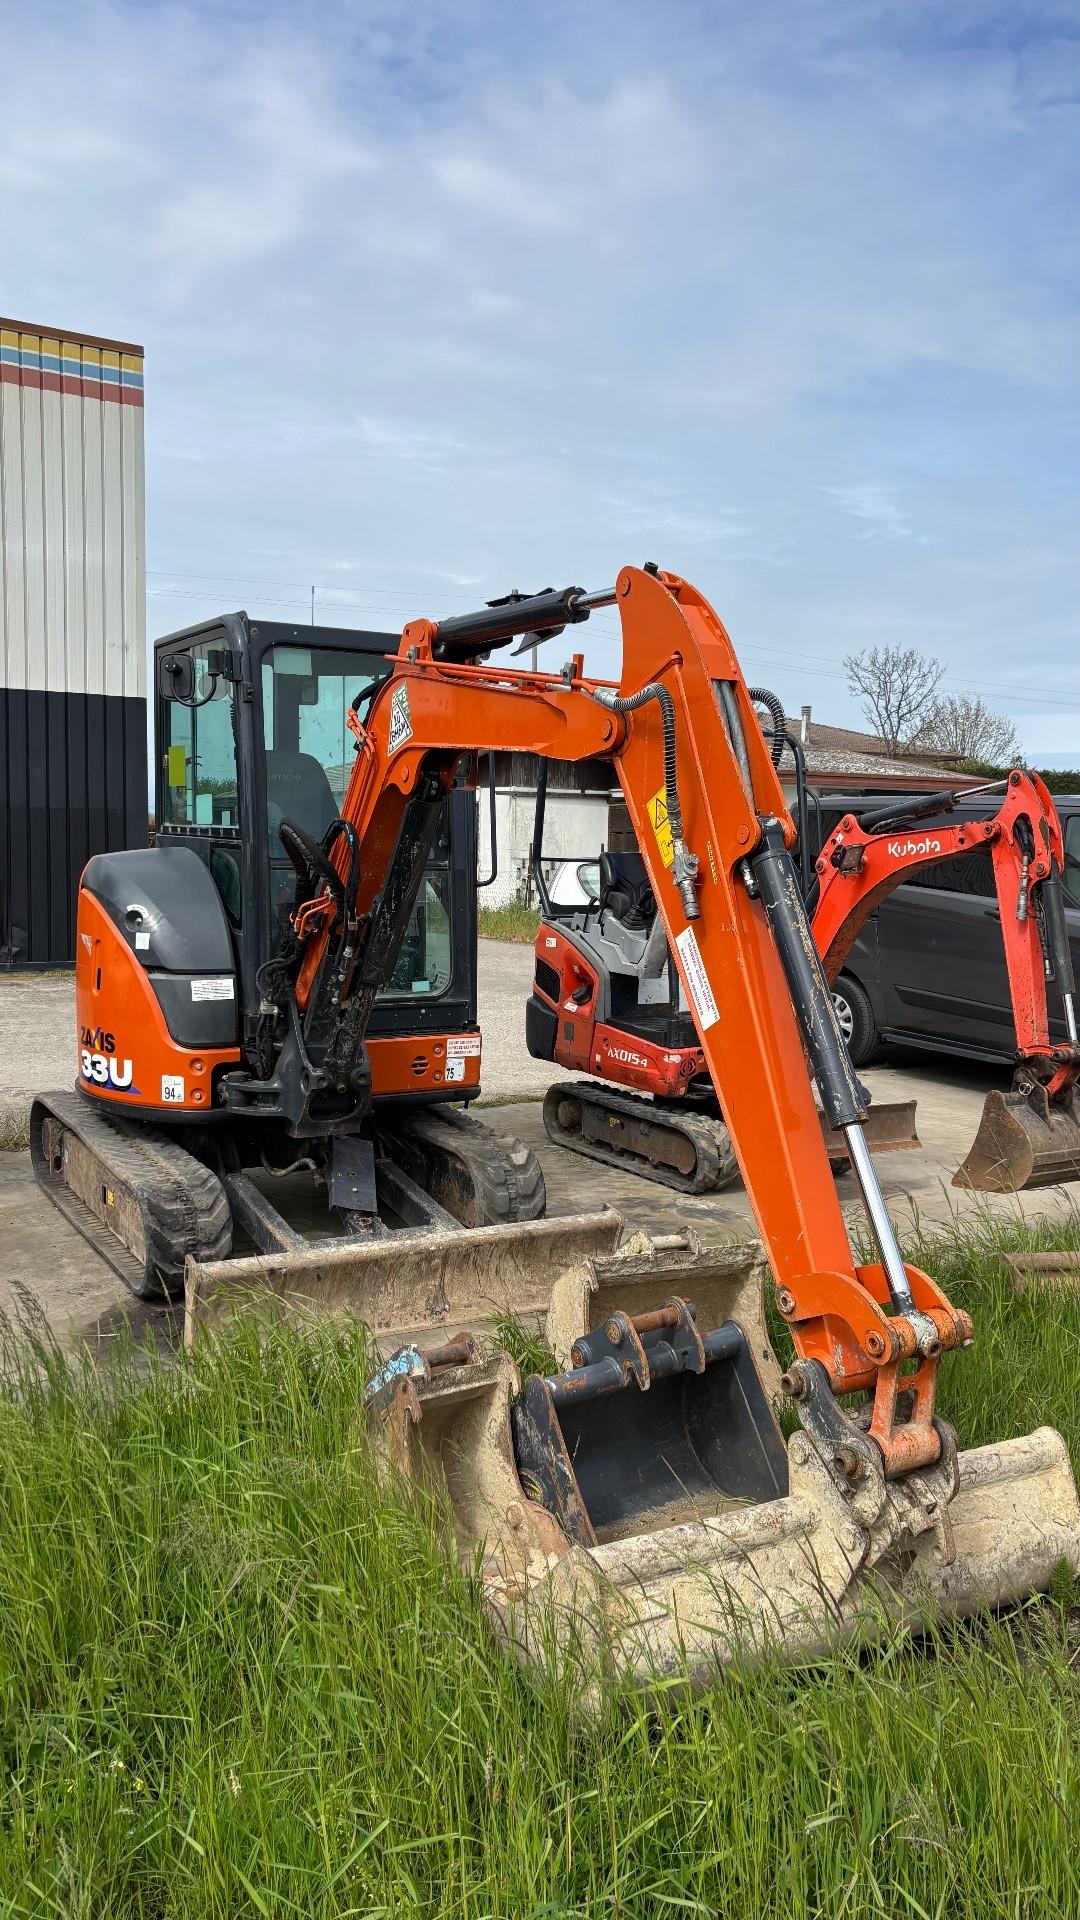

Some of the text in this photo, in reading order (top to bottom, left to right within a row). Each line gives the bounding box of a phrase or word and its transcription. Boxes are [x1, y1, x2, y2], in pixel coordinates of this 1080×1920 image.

[888, 837, 940, 857] Kubota
[692, 943, 703, 972] MACHINE
[81, 1025, 115, 1053] ZAXIS
[81, 1050, 132, 1088] 33U
[446, 1068, 454, 1079] 75
[164, 1086, 175, 1100] 94
